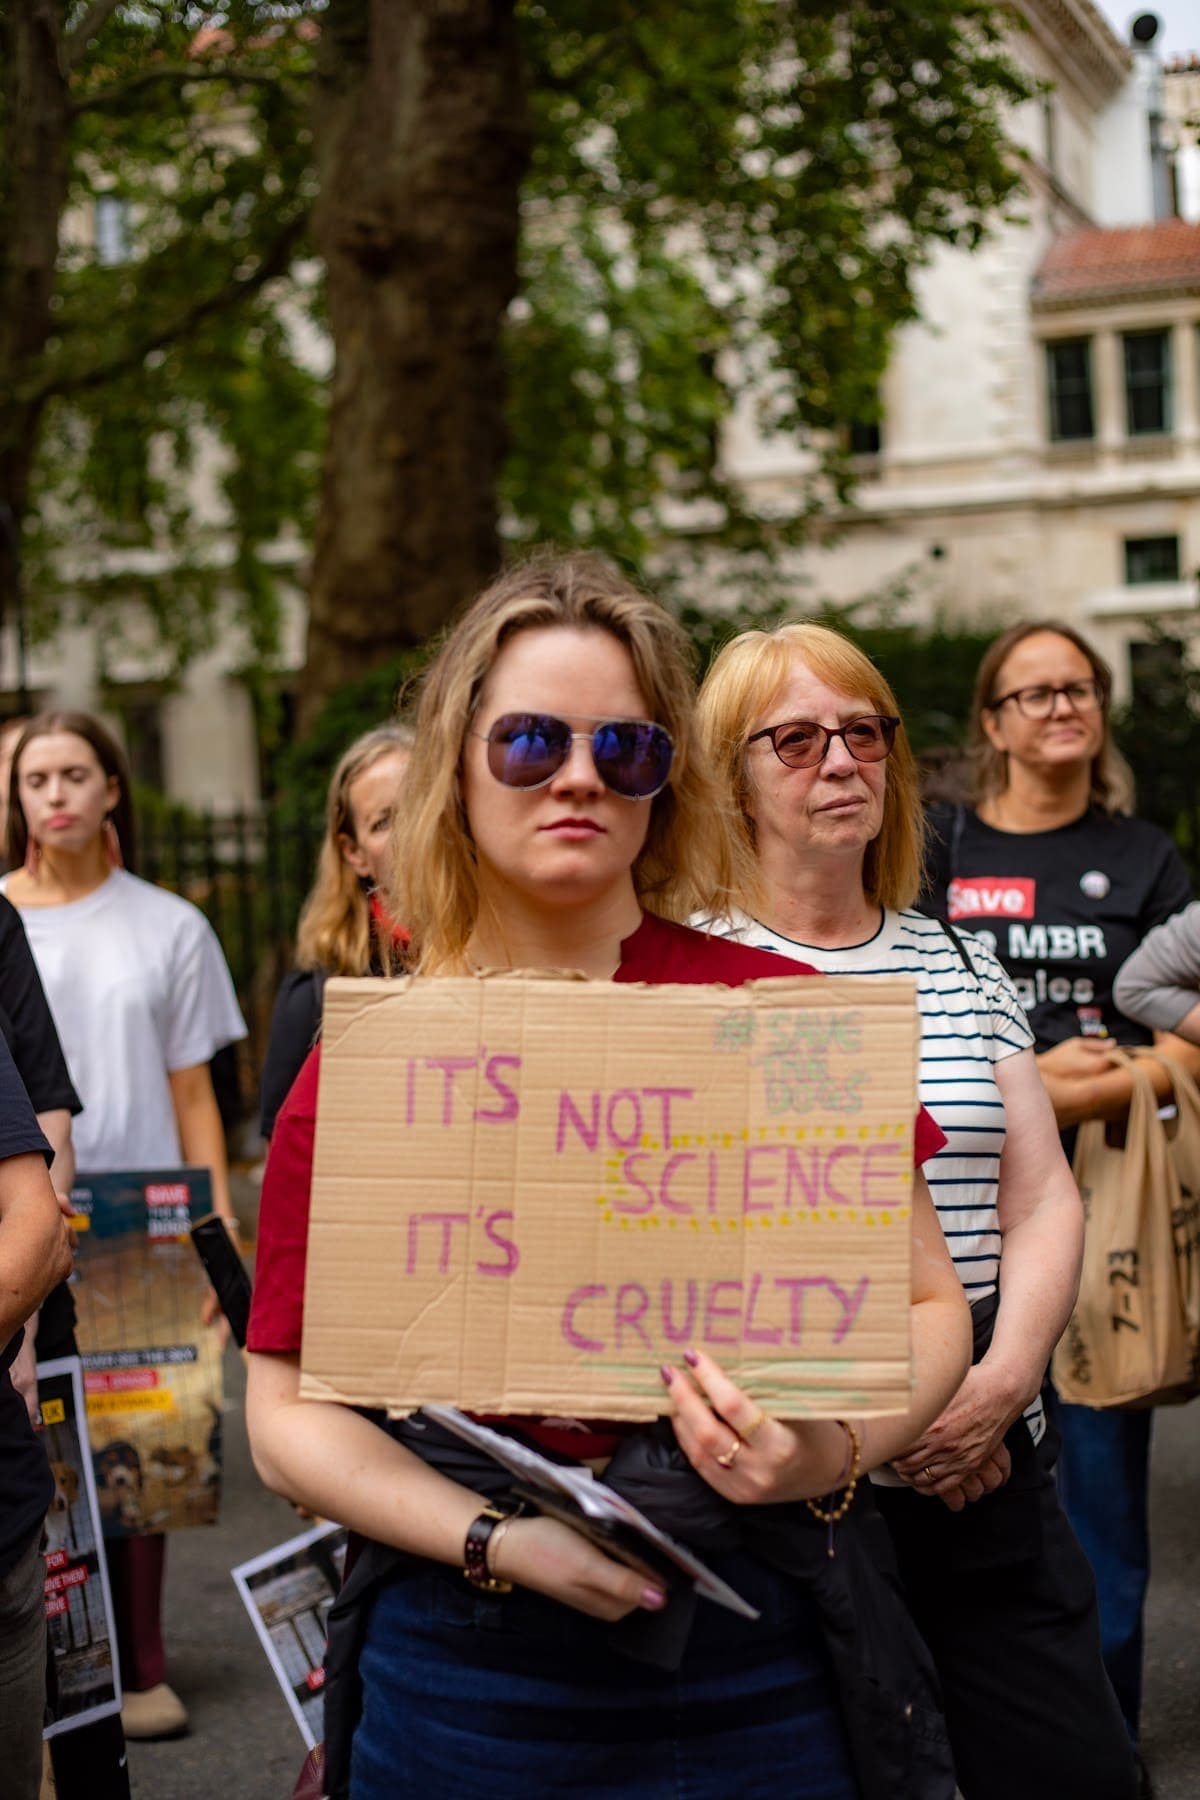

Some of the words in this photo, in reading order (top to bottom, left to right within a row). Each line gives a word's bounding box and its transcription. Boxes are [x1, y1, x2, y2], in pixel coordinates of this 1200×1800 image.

[1008, 924, 1107, 959] MBR
[1013, 969, 1095, 1011] gles
[406, 1046, 522, 1127] IT'S
[556, 1088, 694, 1154] NOT
[613, 1144, 904, 1215] SCIENCE
[405, 1206, 521, 1277] IT'S
[561, 1273, 870, 1352] CRUELTY
